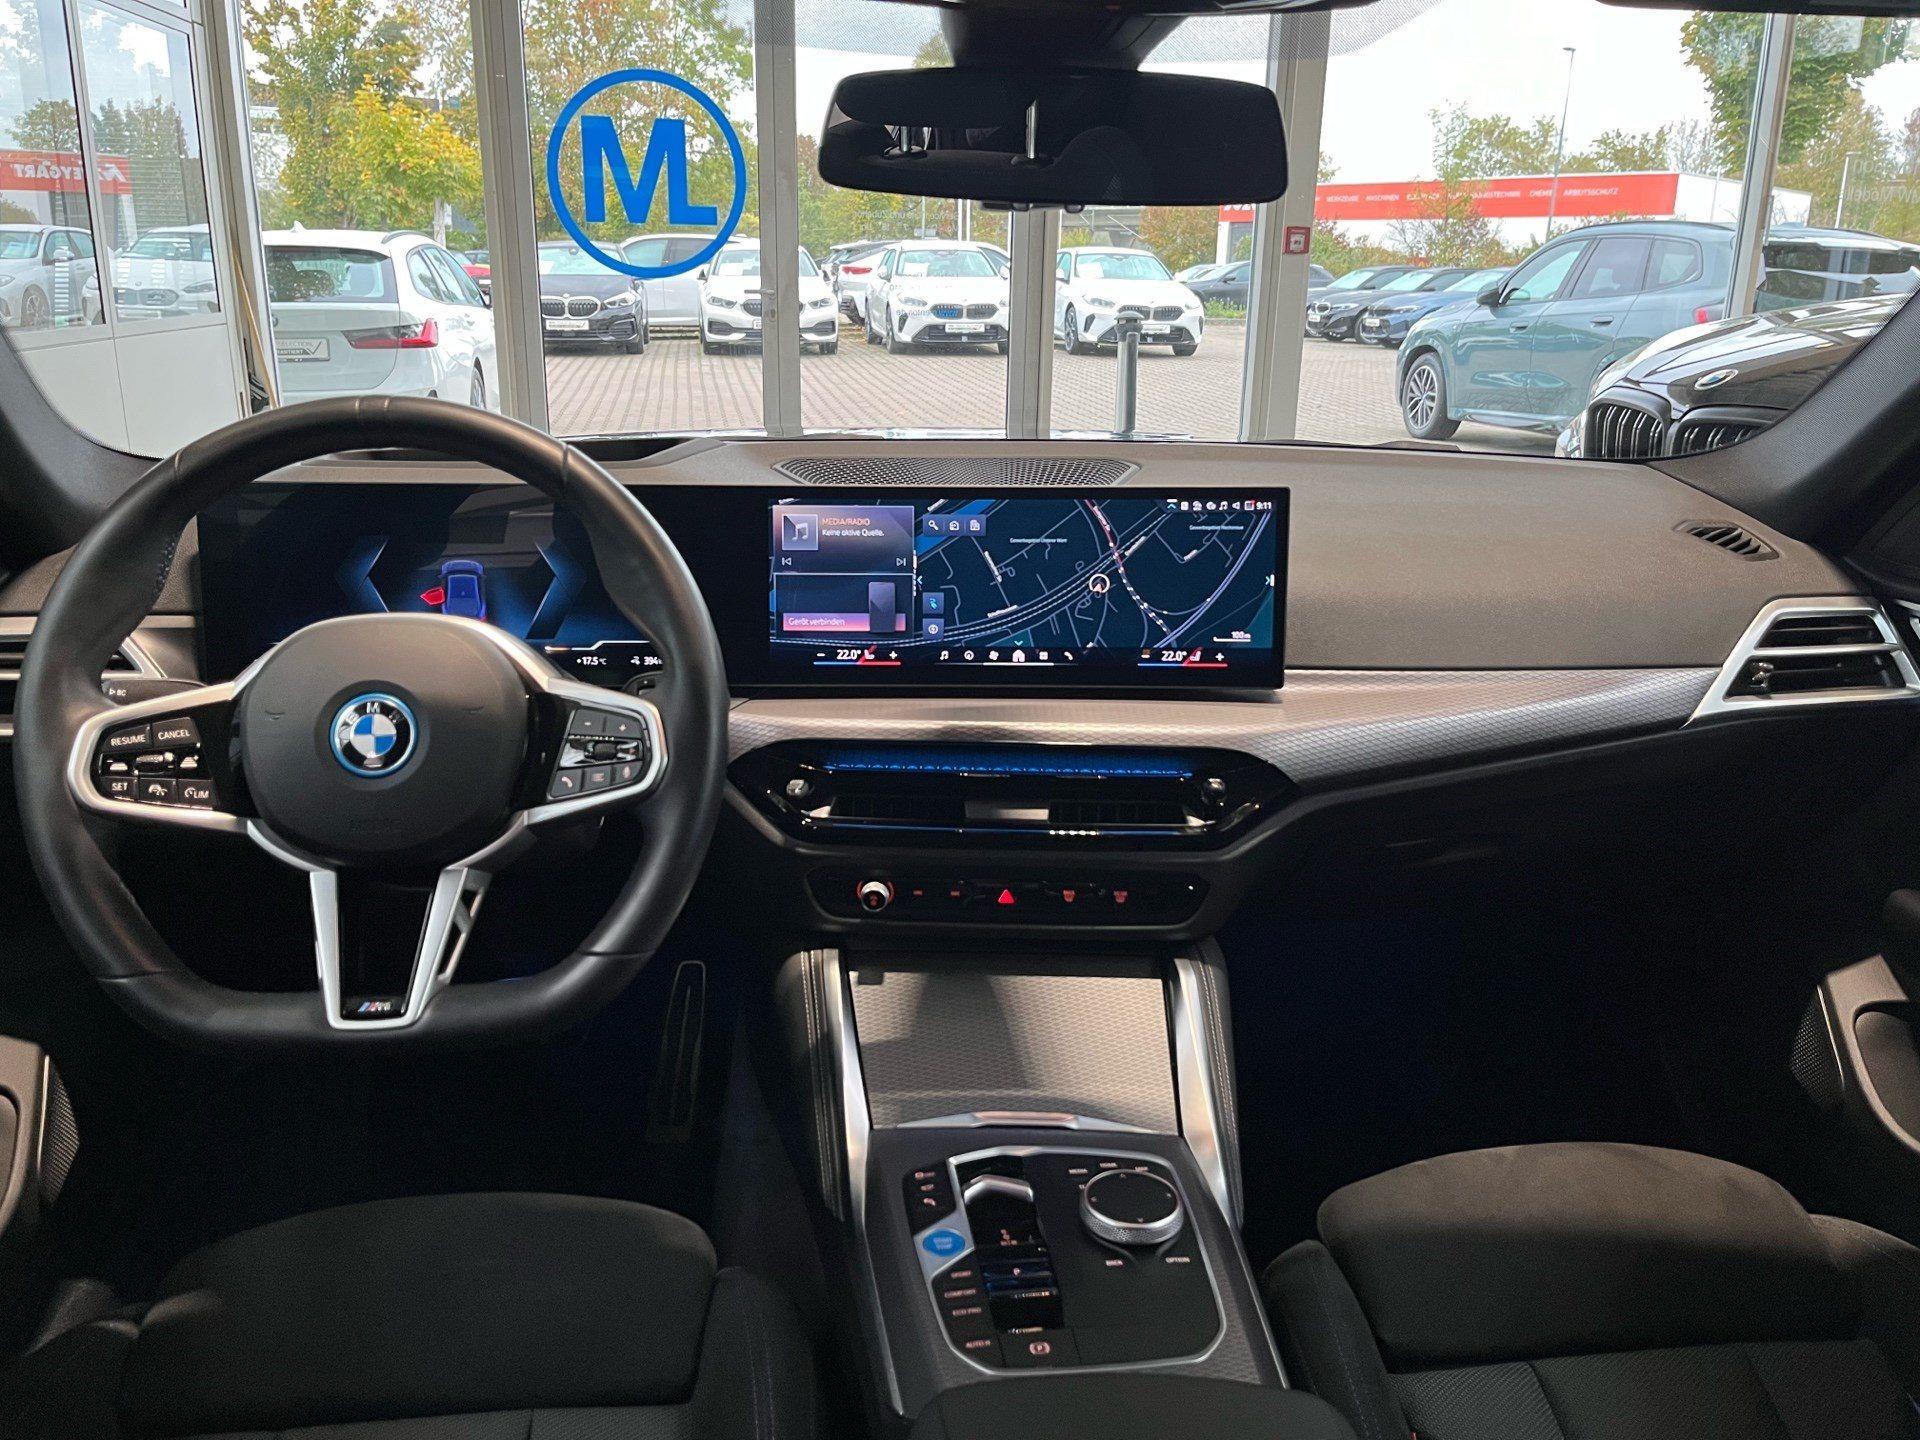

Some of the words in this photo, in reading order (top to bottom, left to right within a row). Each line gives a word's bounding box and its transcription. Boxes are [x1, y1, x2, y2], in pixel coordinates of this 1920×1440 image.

[581, 115, 718, 226] ML
[1256, 501, 1272, 510] 9:11
[822, 518, 871, 526] MEDIA/RADIO
[822, 529, 841, 537] Keine
[809, 617, 846, 626] verbinden
[110, 734, 146, 747] RESUME
[157, 729, 191, 741] CANCEL
[112, 782, 128, 792] SET
[193, 789, 210, 799] LIM
